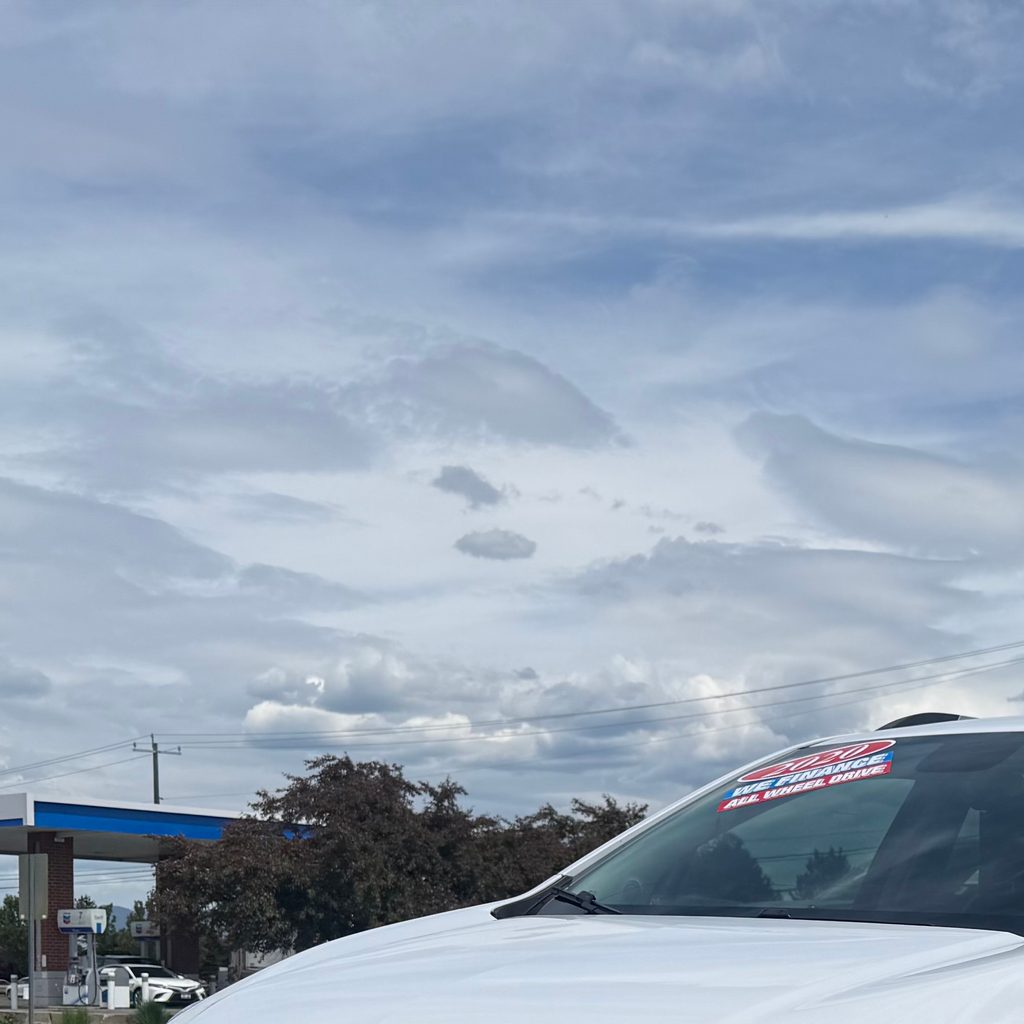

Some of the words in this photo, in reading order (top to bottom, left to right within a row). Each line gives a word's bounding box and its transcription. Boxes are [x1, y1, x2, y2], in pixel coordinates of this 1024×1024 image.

[723, 791, 760, 810] ALL
[763, 778, 826, 801] WHEEL
[828, 764, 888, 784] DRIVE
[731, 779, 773, 798] WE
[774, 752, 889, 788] FINANCE
